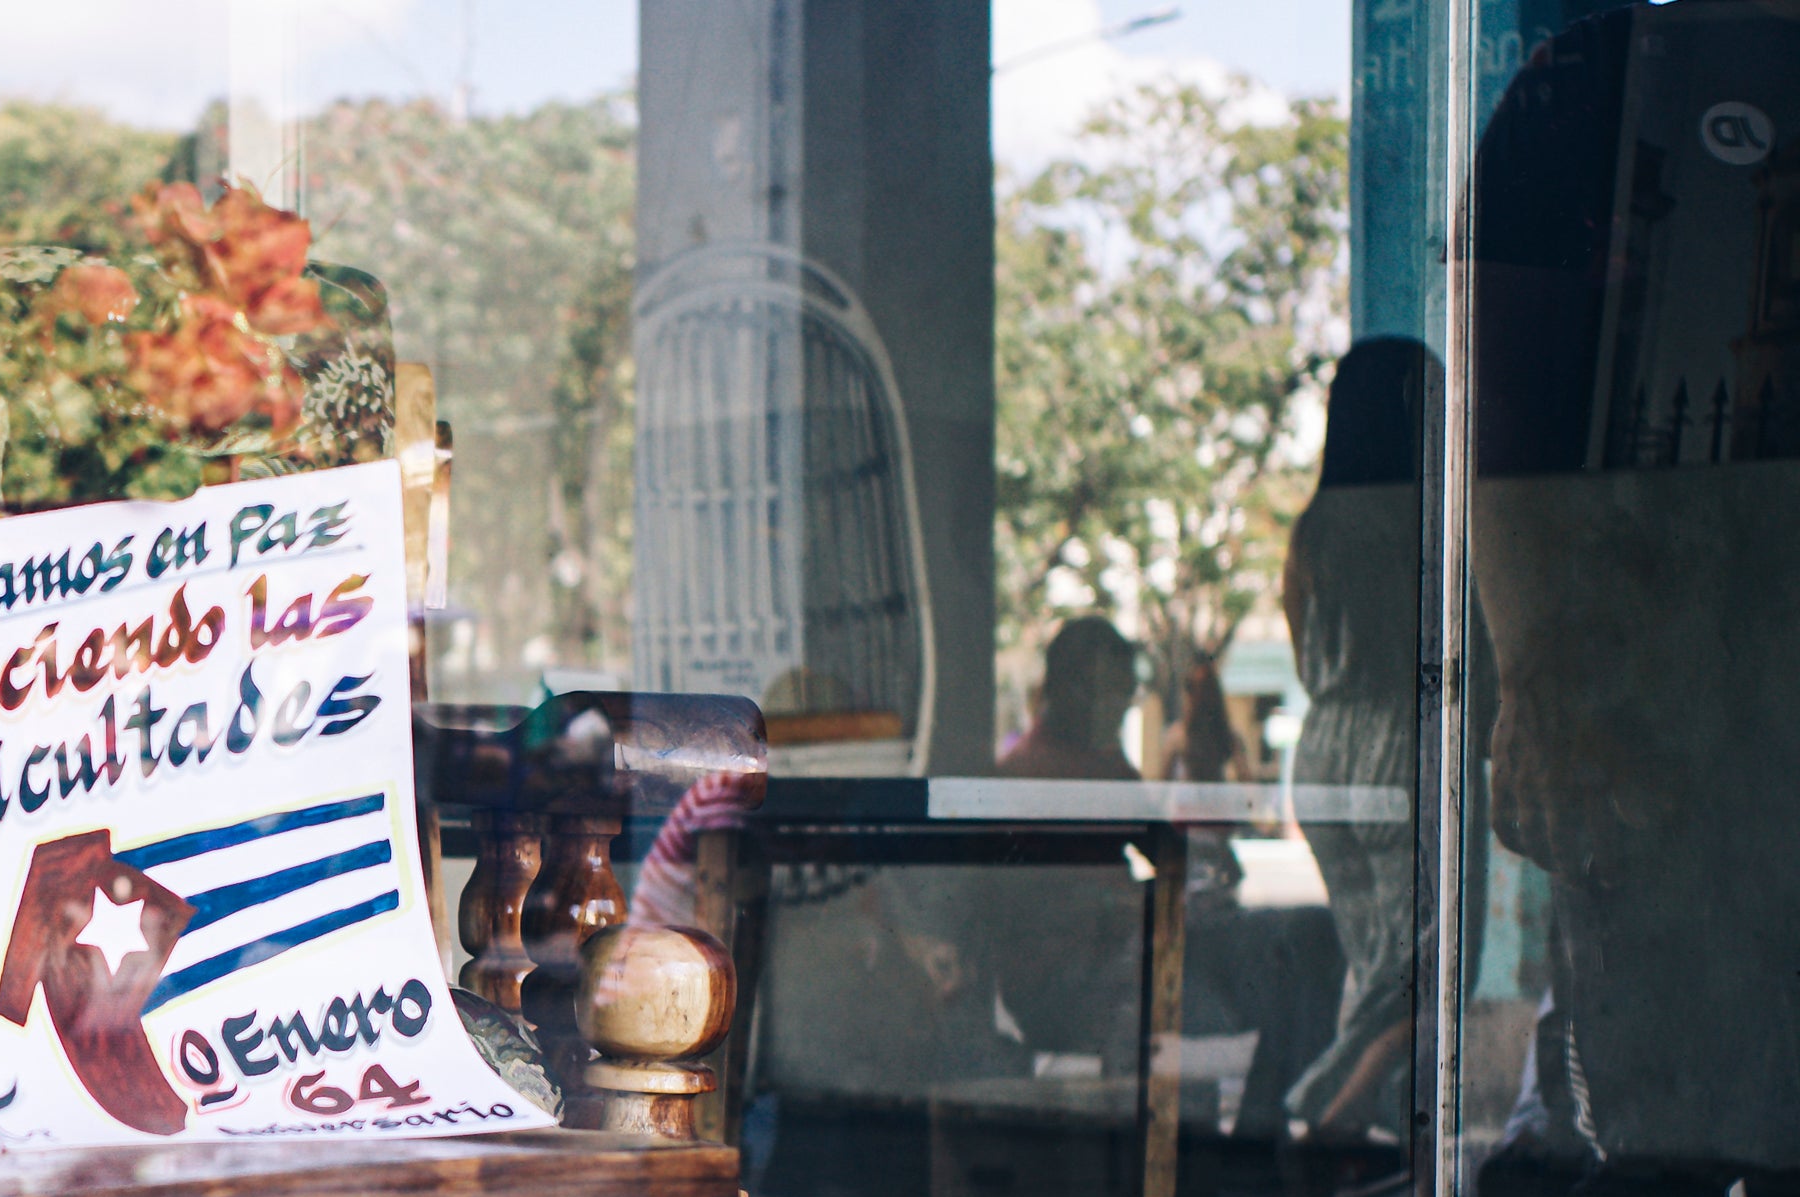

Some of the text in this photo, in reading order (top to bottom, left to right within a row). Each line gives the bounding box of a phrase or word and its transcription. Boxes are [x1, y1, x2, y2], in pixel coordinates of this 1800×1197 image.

[145, 517, 212, 580] en
[228, 499, 351, 569] Paz
[246, 573, 374, 650] las
[221, 978, 433, 1077] Enero
[290, 1063, 432, 1116] 64
